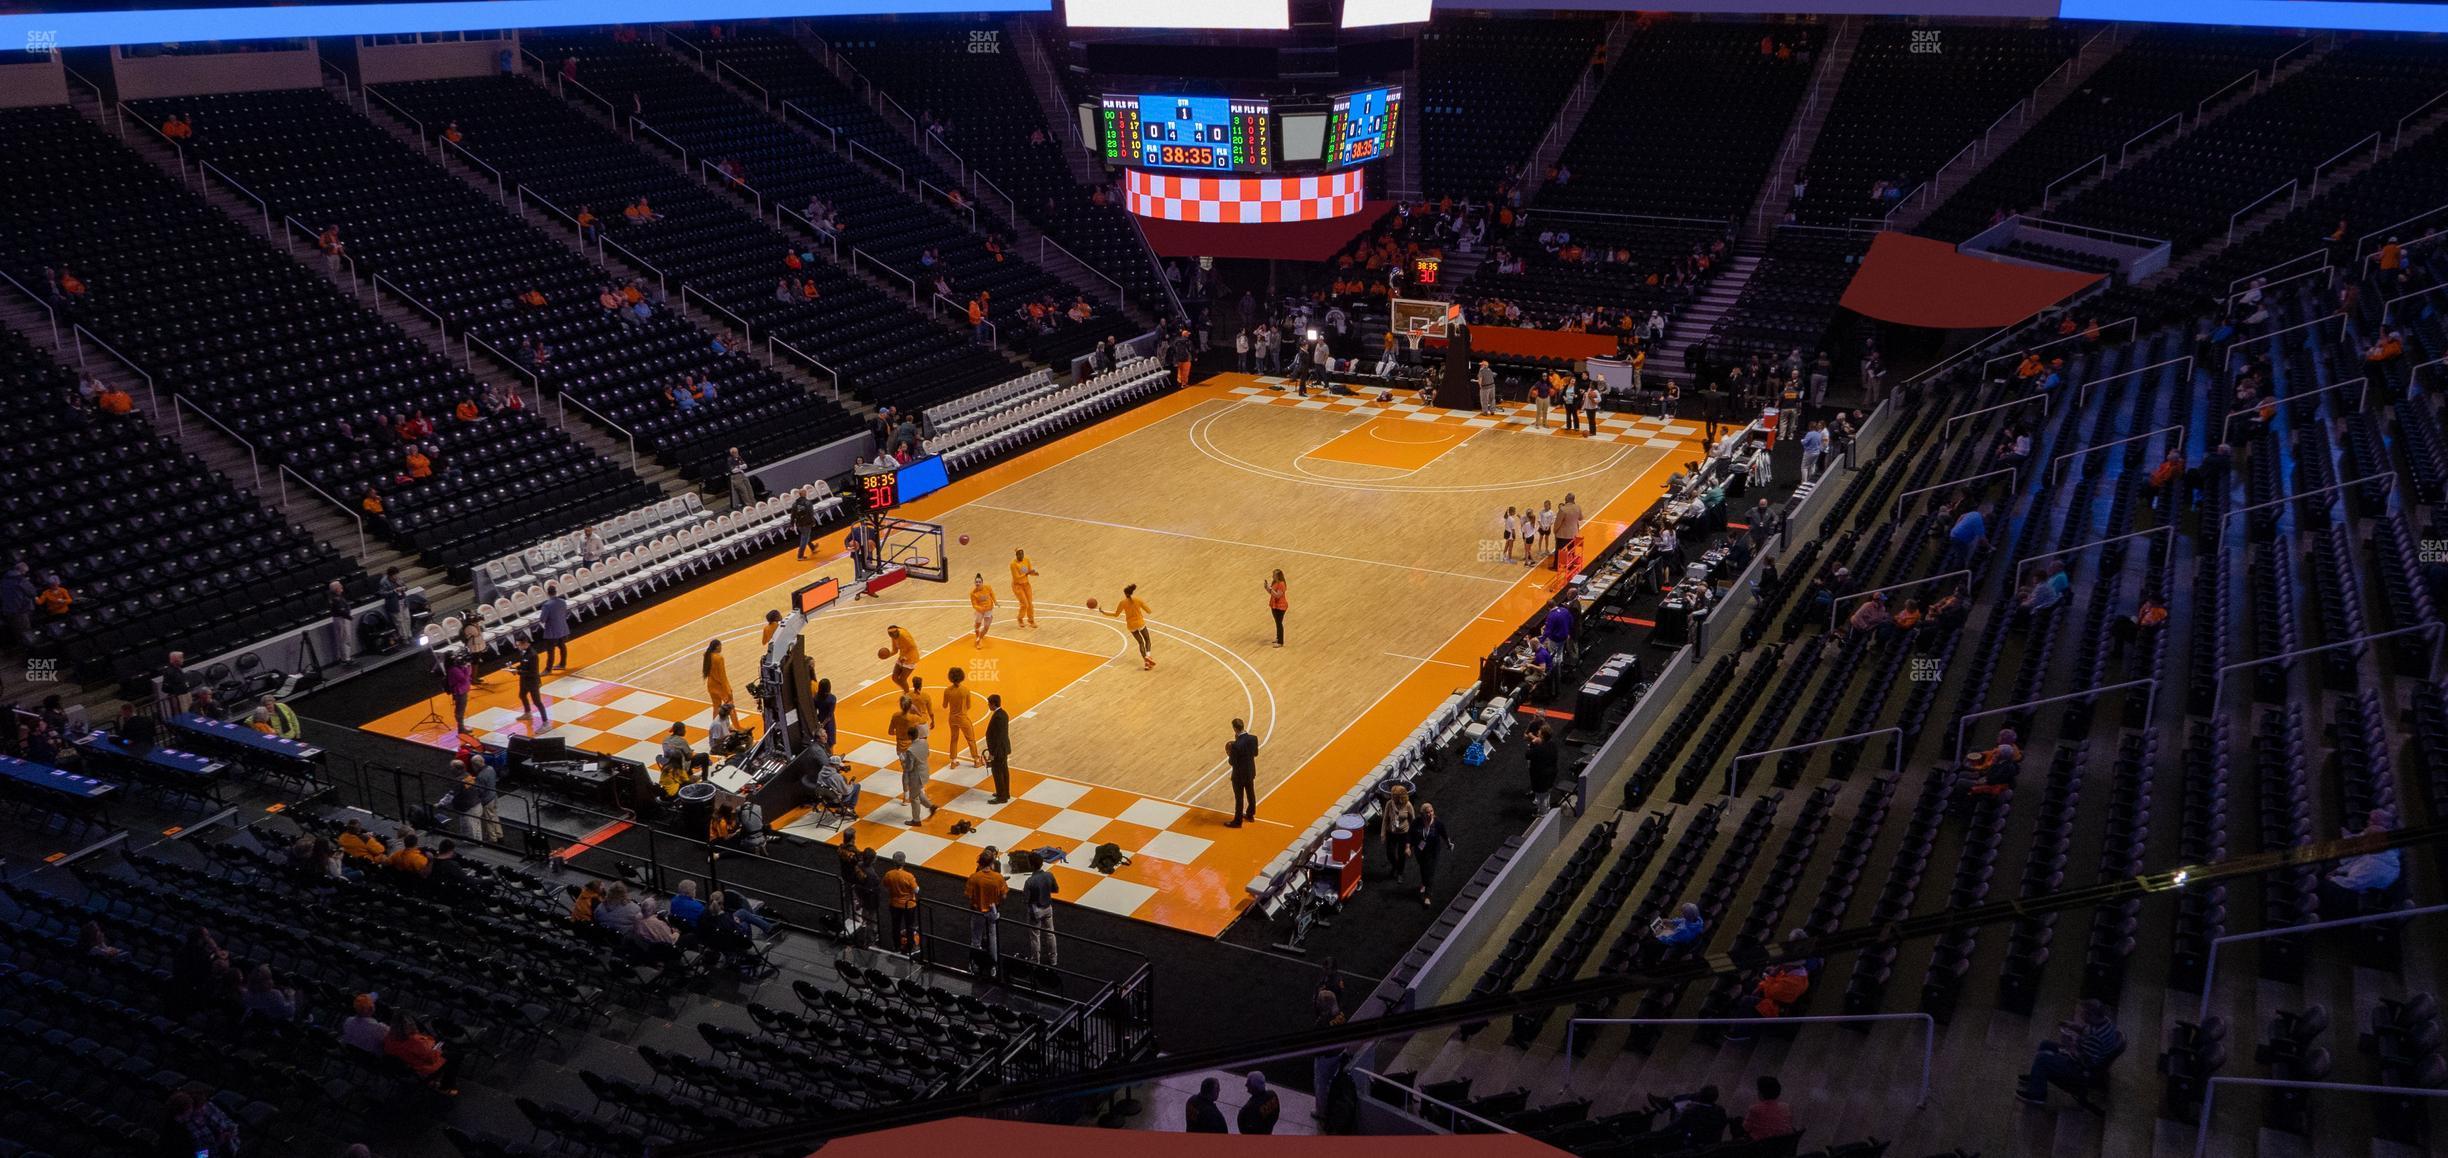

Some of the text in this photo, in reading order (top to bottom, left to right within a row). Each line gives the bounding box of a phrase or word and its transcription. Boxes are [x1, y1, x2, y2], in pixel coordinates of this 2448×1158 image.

[1105, 111, 1114, 119] 00
[1182, 108, 1187, 119] 1
[1130, 122, 1139, 130] 17
[1350, 123, 1354, 135] 0
[1376, 118, 1380, 130] 0
[1151, 126, 1157, 137] 0
[1170, 131, 1175, 140] 4
[1196, 132, 1202, 141] 4
[1214, 128, 1221, 140] 0
[1132, 141, 1141, 149] 10
[1261, 137, 1265, 145] 7
[1352, 140, 1372, 158] 38:35
[1150, 155, 1155, 163] 0
[1163, 147, 1212, 164] 38:35
[1234, 156, 1267, 165] 24 0 0
[1219, 158, 1224, 166] 0
[1417, 261, 1438, 271] 38:35
[1420, 269, 1435, 283] 30
[863, 472, 895, 489] 38:35
[869, 486, 892, 509] 30
